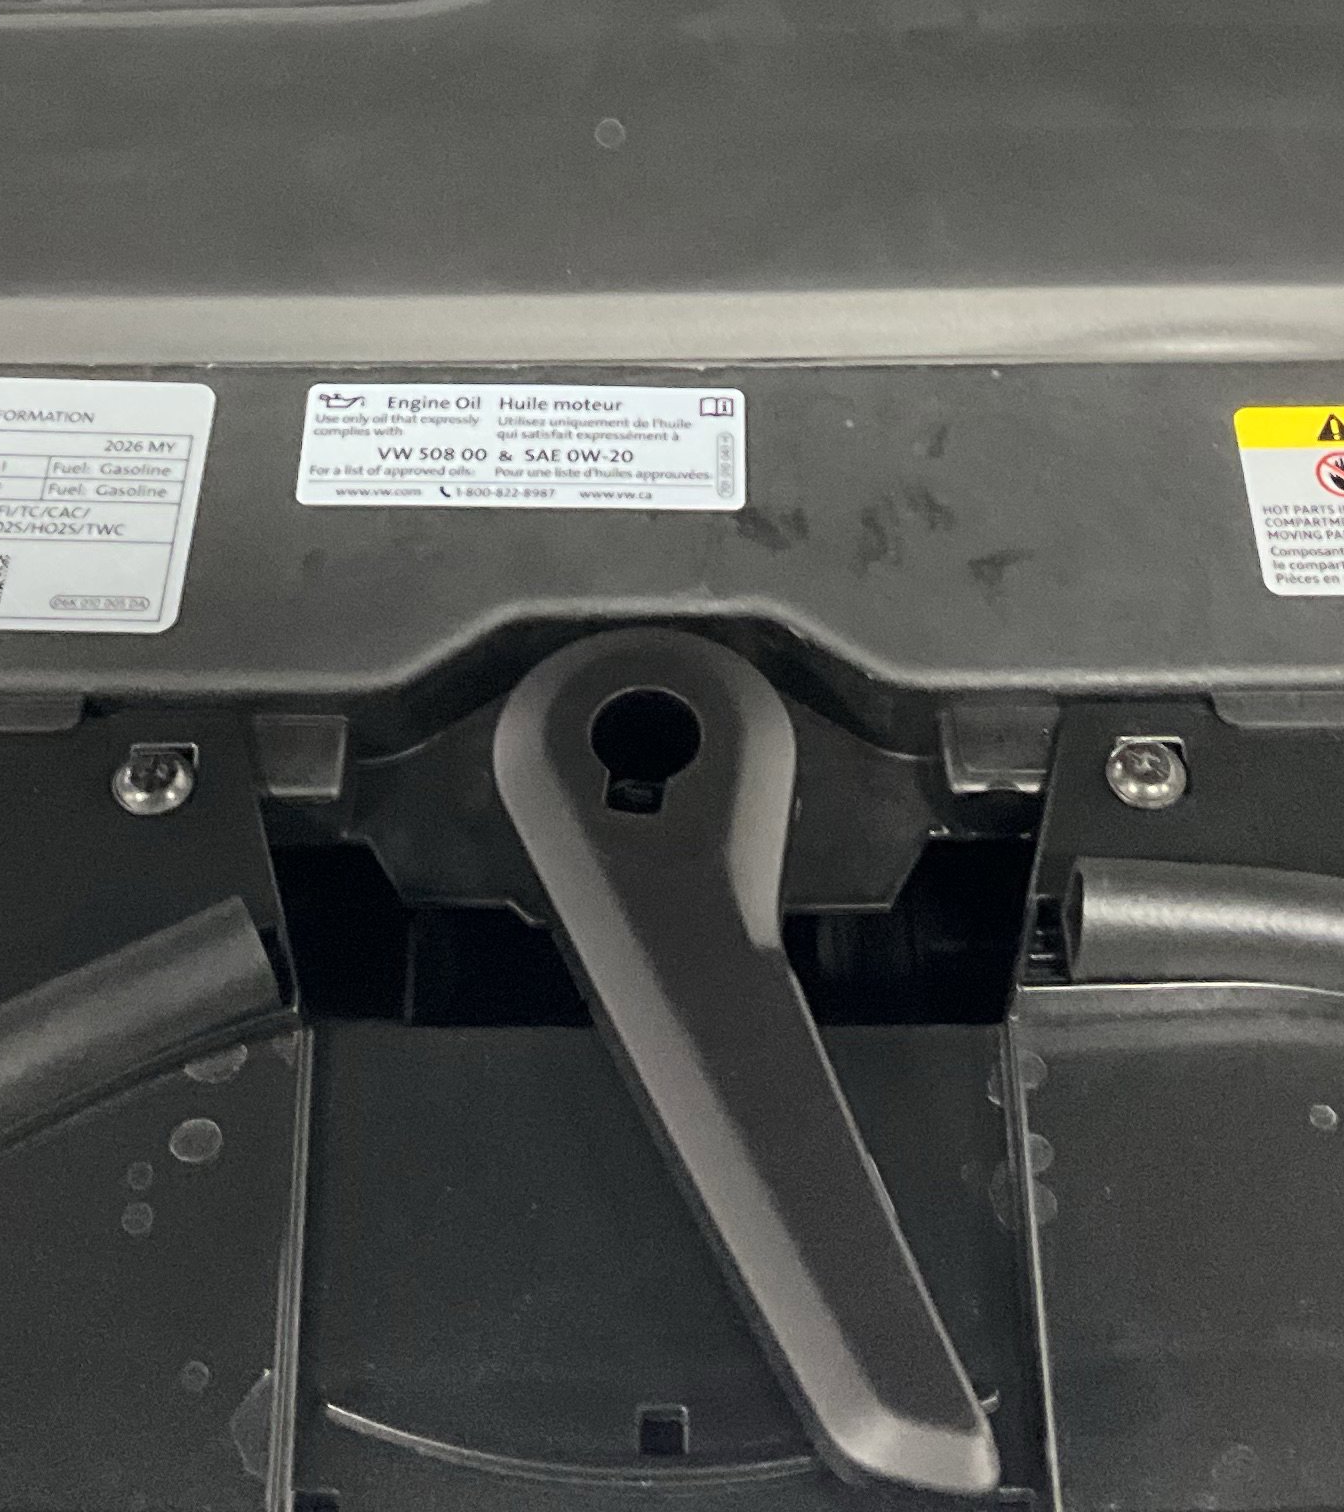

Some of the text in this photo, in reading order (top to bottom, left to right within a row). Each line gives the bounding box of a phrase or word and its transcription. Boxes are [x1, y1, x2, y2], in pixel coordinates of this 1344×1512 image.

[387, 395, 482, 412] Engine Oil
[498, 396, 623, 411] Huile moteur
[315, 414, 480, 427] Use only oil that expressly
[498, 416, 546, 428] Utilisez
[549, 417, 630, 431] uniquement
[633, 419, 649, 429] de
[313, 426, 404, 438] complies with
[497, 430, 518, 442] qui
[521, 429, 573, 440] satisfait
[103, 440, 144, 454] 2026
[147, 442, 177, 455] MY
[378, 447, 634, 464] VW 508 00 & SAE 0W-20
[100, 462, 172, 478] Gasoline
[308, 465, 330, 477] For
[332, 467, 342, 477] a
[344, 466, 364, 477] list
[366, 465, 382, 477] of
[383, 466, 446, 479] approved
[495, 468, 524, 478] Pour
[527, 469, 552, 479] une
[554, 468, 581, 479] liste
[94, 484, 168, 499] Gasoline
[335, 487, 653, 501] www.vw.com 1-800-822-8987 www.vw.ca
[1262, 504, 1290, 516] HOT
[1293, 504, 1336, 516] PARTS
[1267, 529, 1323, 541] MOVING
[1273, 559, 1286, 571] le
[1323, 574, 1342, 585] en
